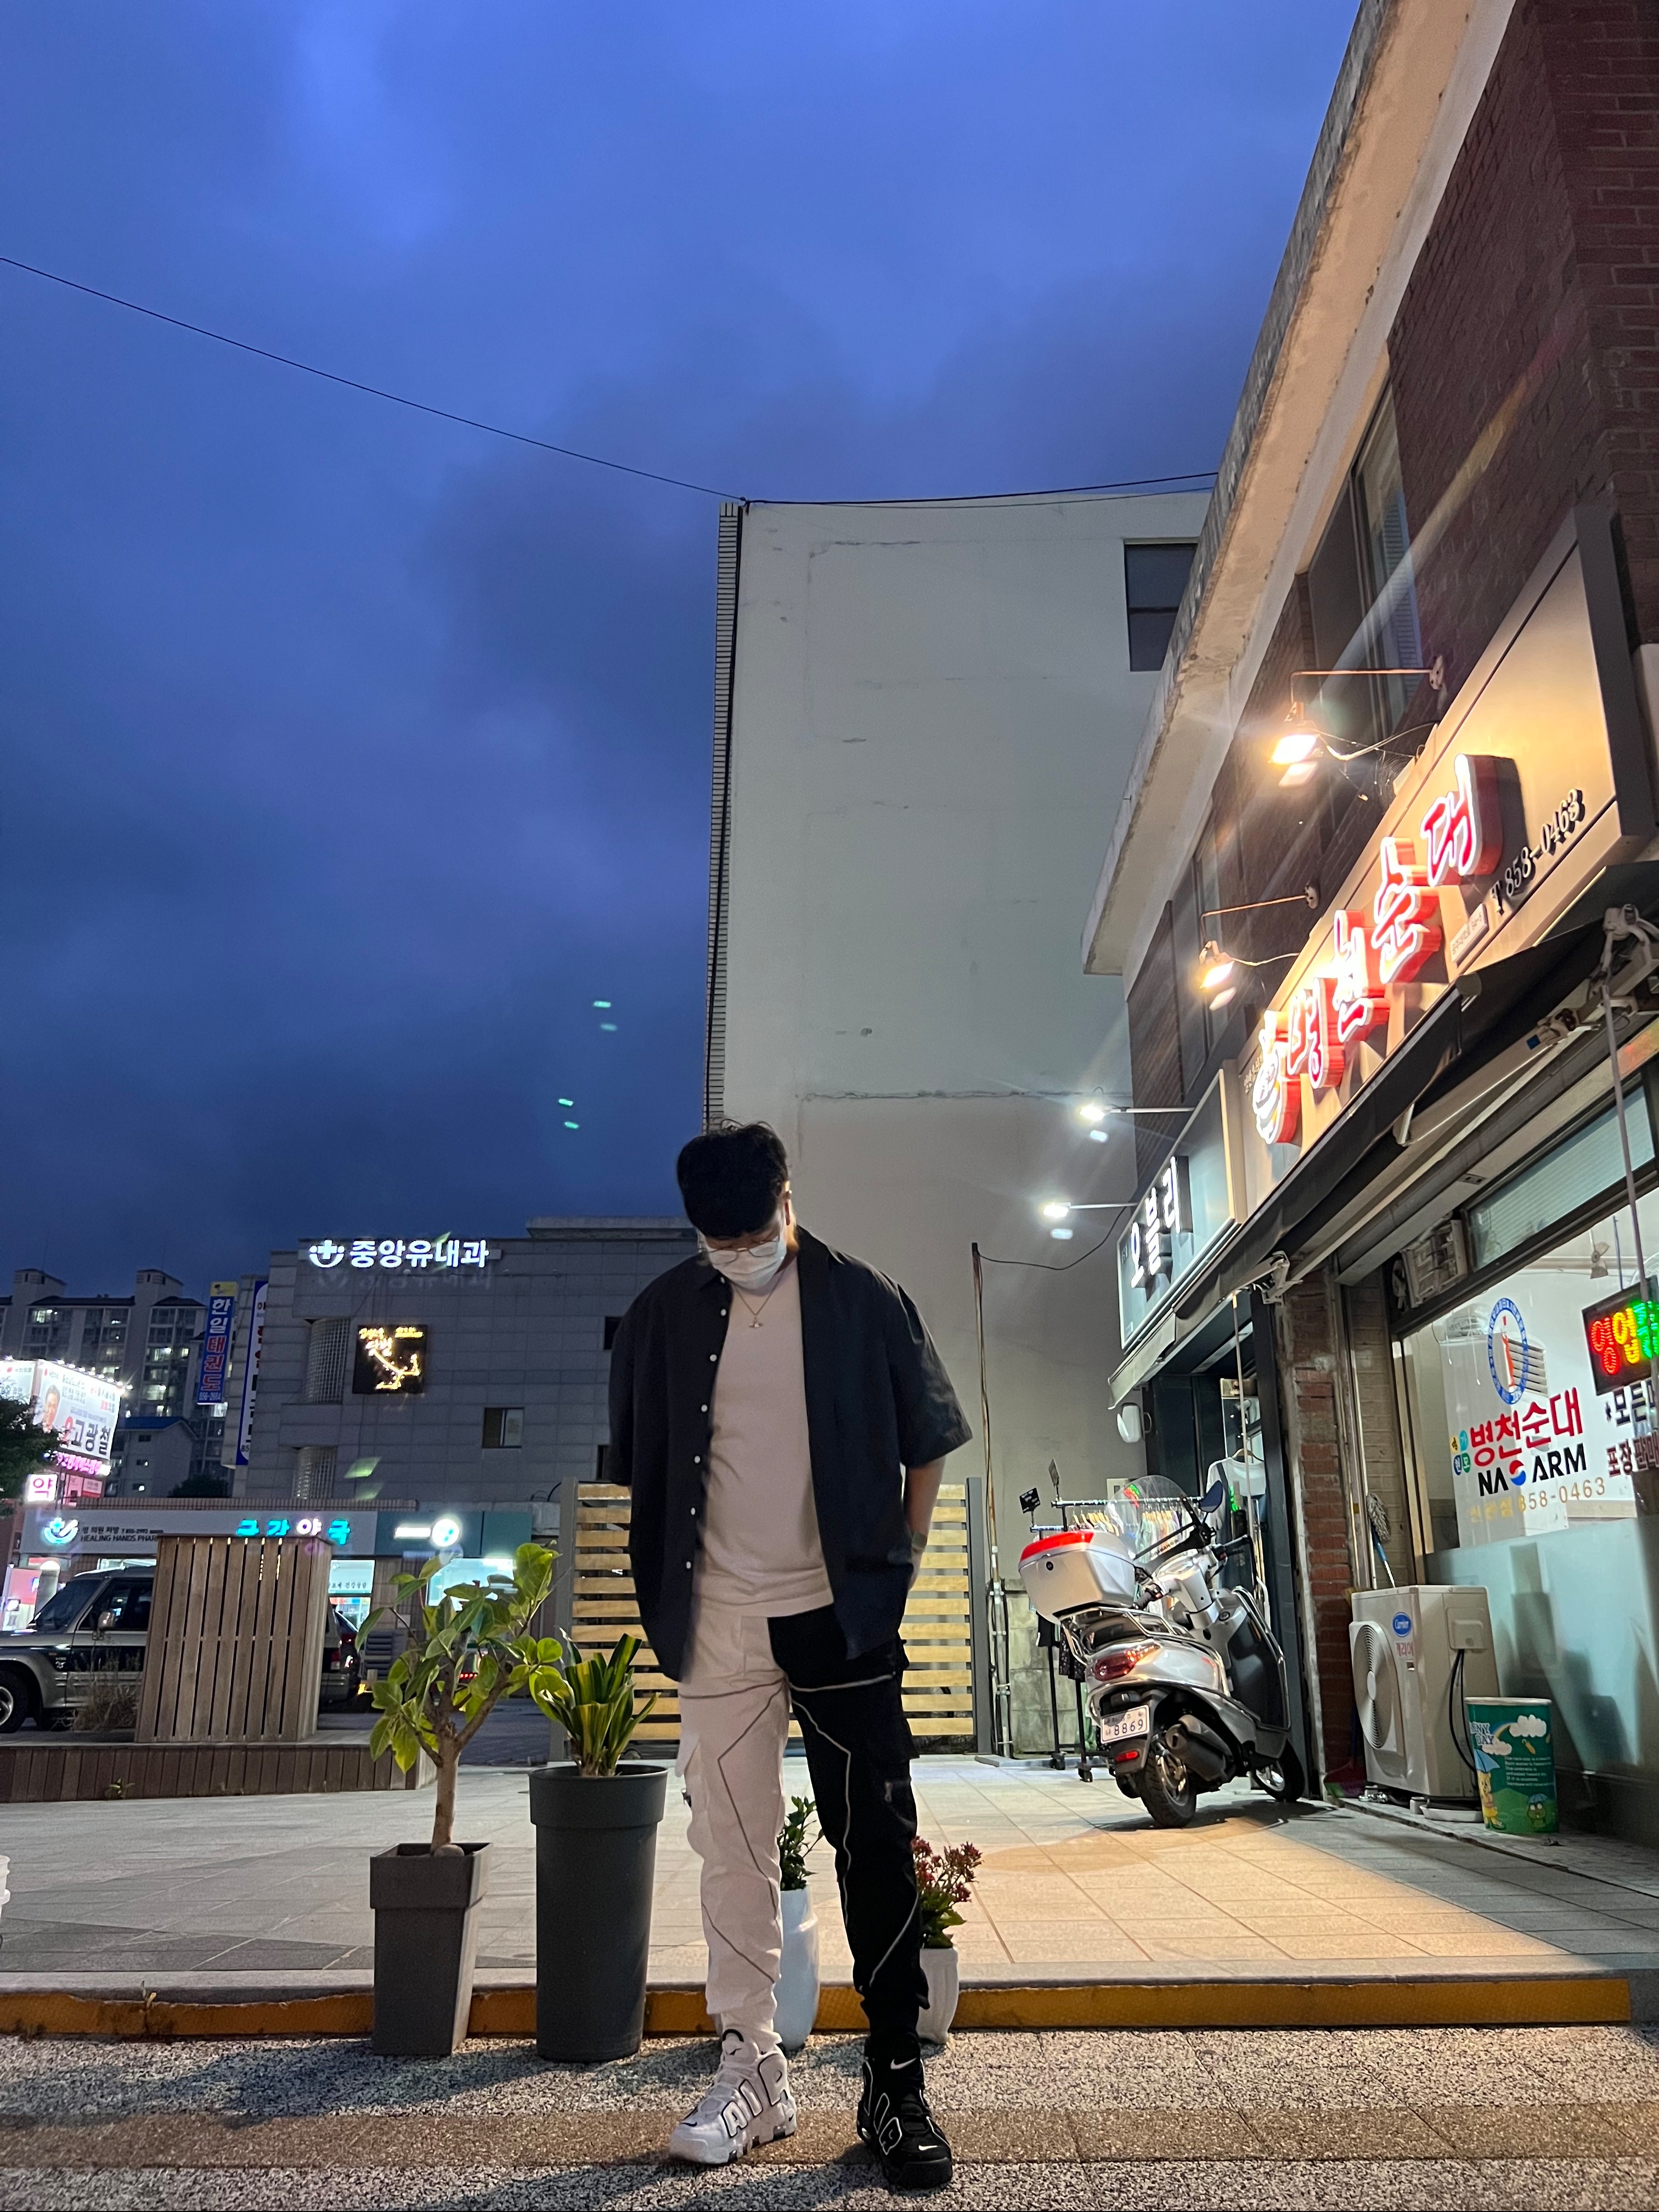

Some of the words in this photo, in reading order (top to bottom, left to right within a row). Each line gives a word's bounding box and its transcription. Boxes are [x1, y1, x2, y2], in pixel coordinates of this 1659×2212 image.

[1505, 788, 1584, 897] 858-0463
[350, 1239, 489, 1268] 중앙유내과
[201, 1299, 231, 1391] 한일태권도
[71, 1420, 111, 1455] 고광철
[1470, 1387, 1583, 1467] 병천순대
[33, 1477, 54, 1498] 약
[1518, 1477, 1605, 1513] 858-0463
[1114, 1719, 1143, 1736] 8869
[1476, 1734, 1494, 1746] DAY
[721, 2051, 788, 2138] AIR
